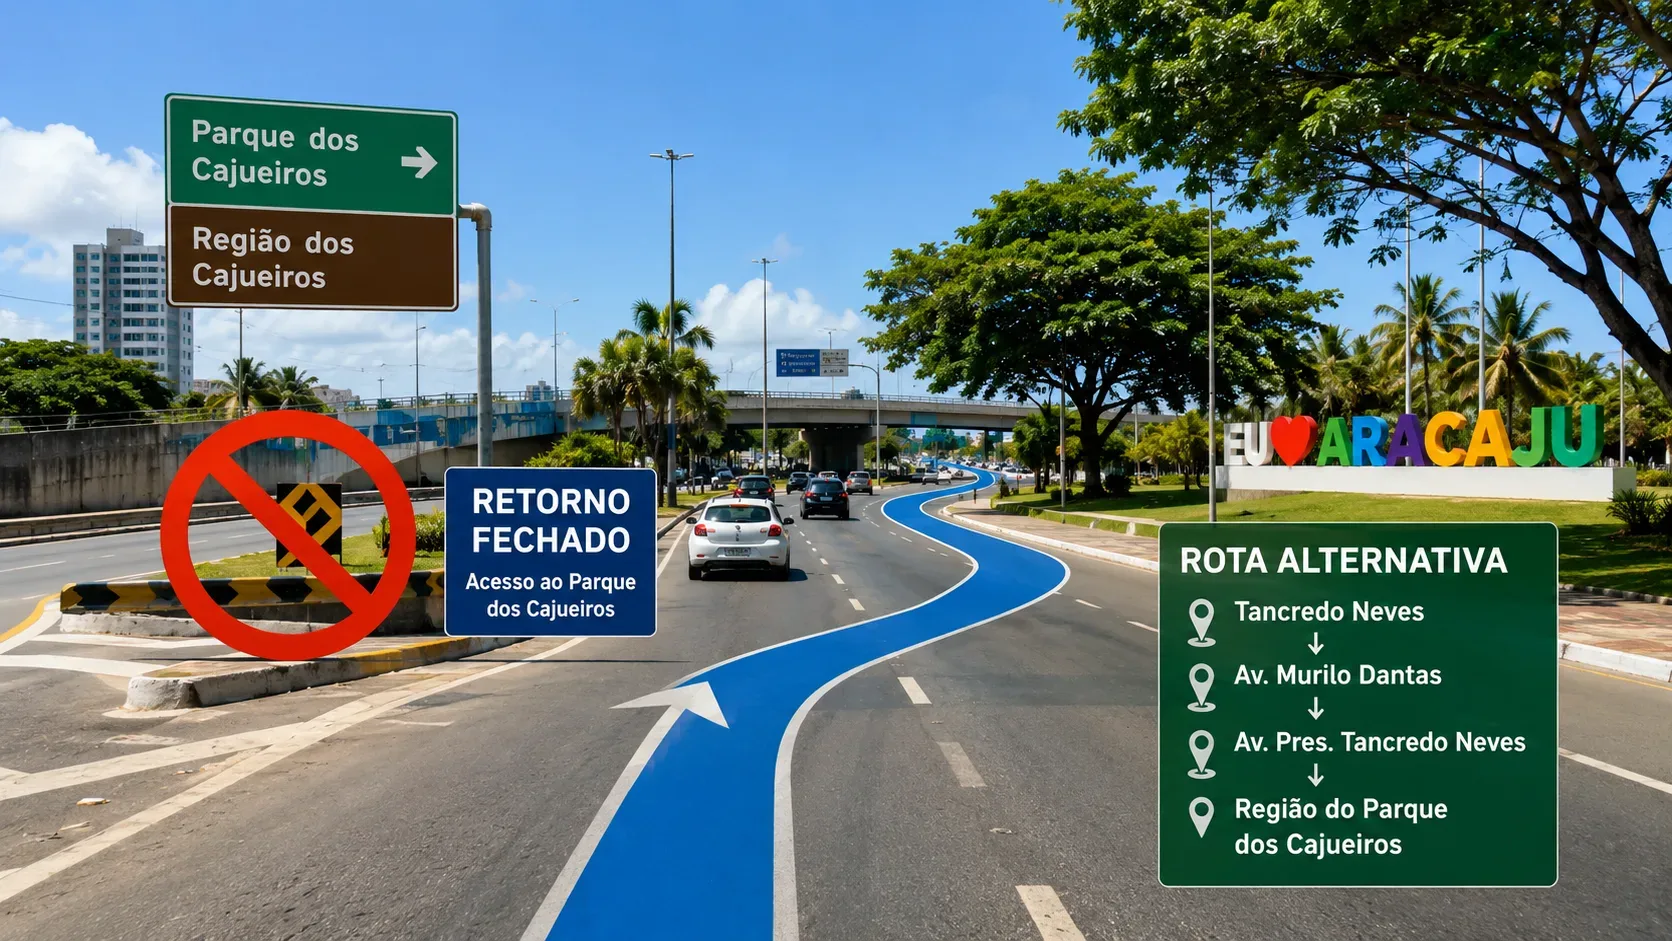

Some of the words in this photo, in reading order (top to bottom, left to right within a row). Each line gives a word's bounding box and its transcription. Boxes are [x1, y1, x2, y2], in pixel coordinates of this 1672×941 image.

[193, 120, 294, 151] Parque
[310, 127, 358, 151] dos
[193, 157, 326, 187] Cajueiros
[194, 227, 290, 256] Região
[306, 231, 353, 254] dos
[193, 263, 325, 291] Cajueiros
[1223, 421, 1272, 467] EU
[1316, 403, 1604, 467] ARACAJU
